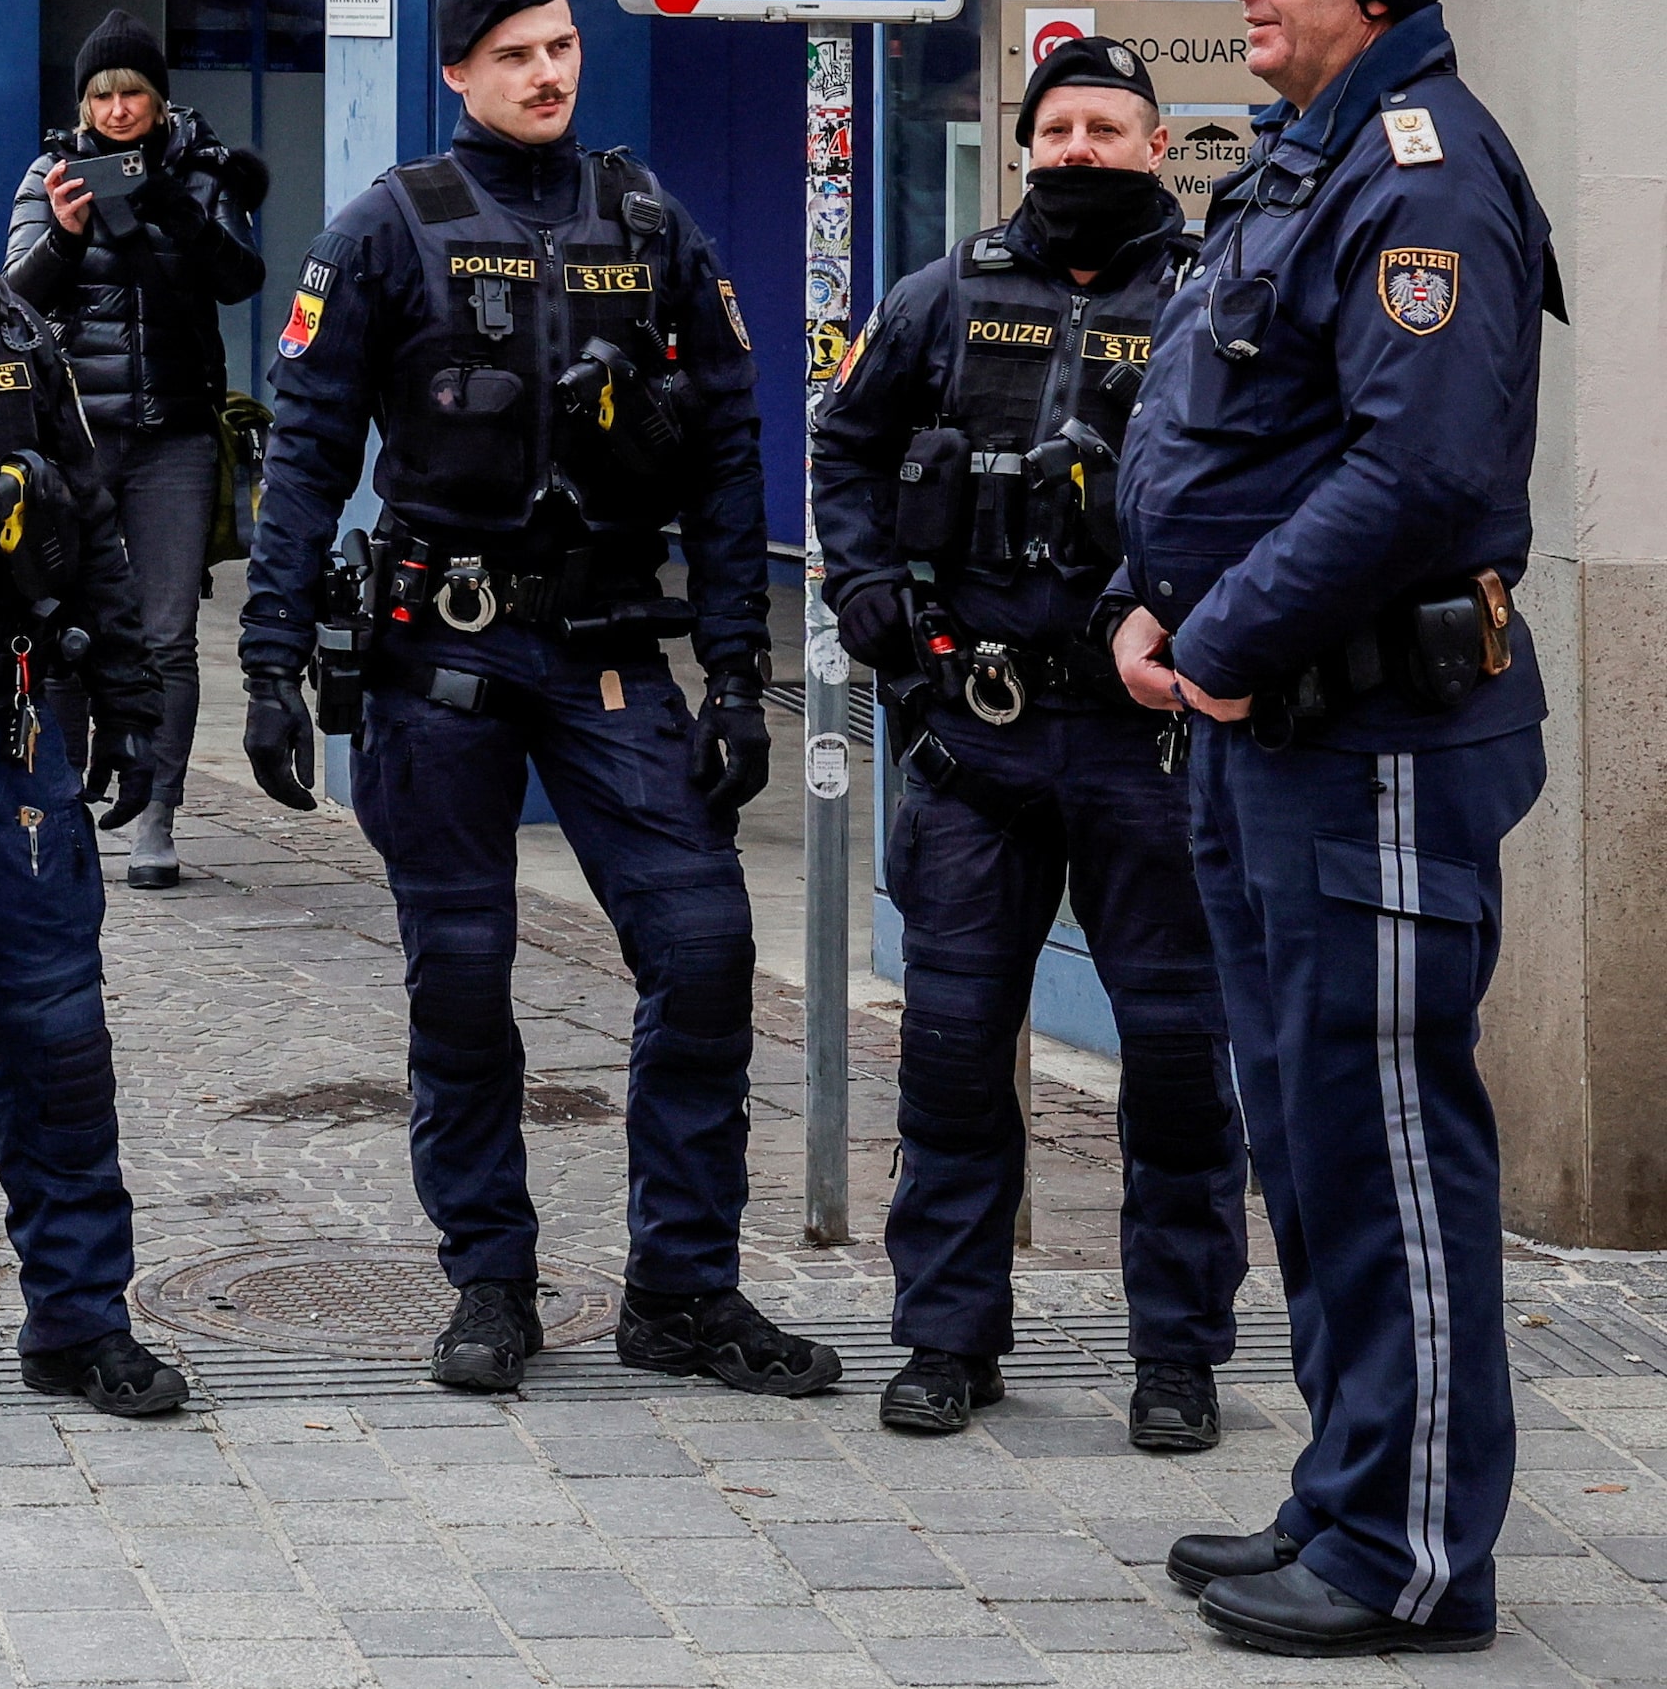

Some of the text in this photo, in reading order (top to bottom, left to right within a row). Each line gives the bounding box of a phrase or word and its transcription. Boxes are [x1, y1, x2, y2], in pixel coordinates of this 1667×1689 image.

[1164, 146, 1190, 161] er
[1174, 175, 1211, 194] Wei
[450, 256, 536, 279] POLIZEI
[1388, 252, 1453, 271] POLIZEI
[583, 272, 636, 290] SIG
[293, 308, 317, 330] SIG
[968, 320, 1063, 346] POLIZEI
